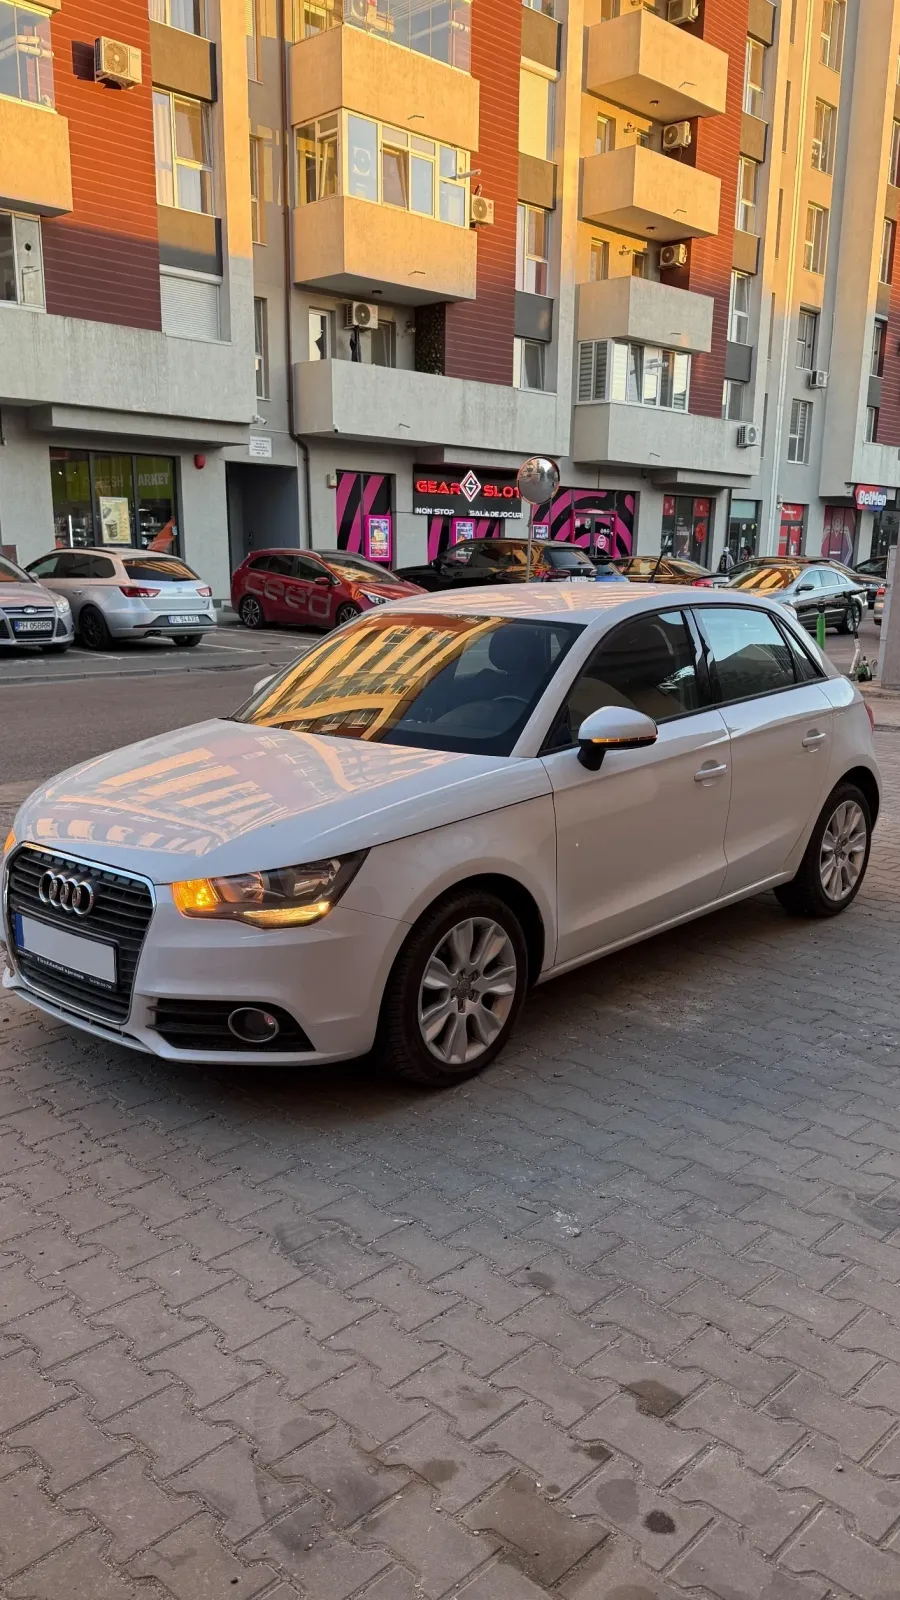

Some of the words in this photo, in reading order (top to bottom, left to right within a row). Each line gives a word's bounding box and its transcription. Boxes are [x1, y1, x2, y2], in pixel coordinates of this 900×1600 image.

[416, 480, 461, 495] GEAR
[858, 490, 887, 506] BetMen
[415, 507, 432, 515] NON
